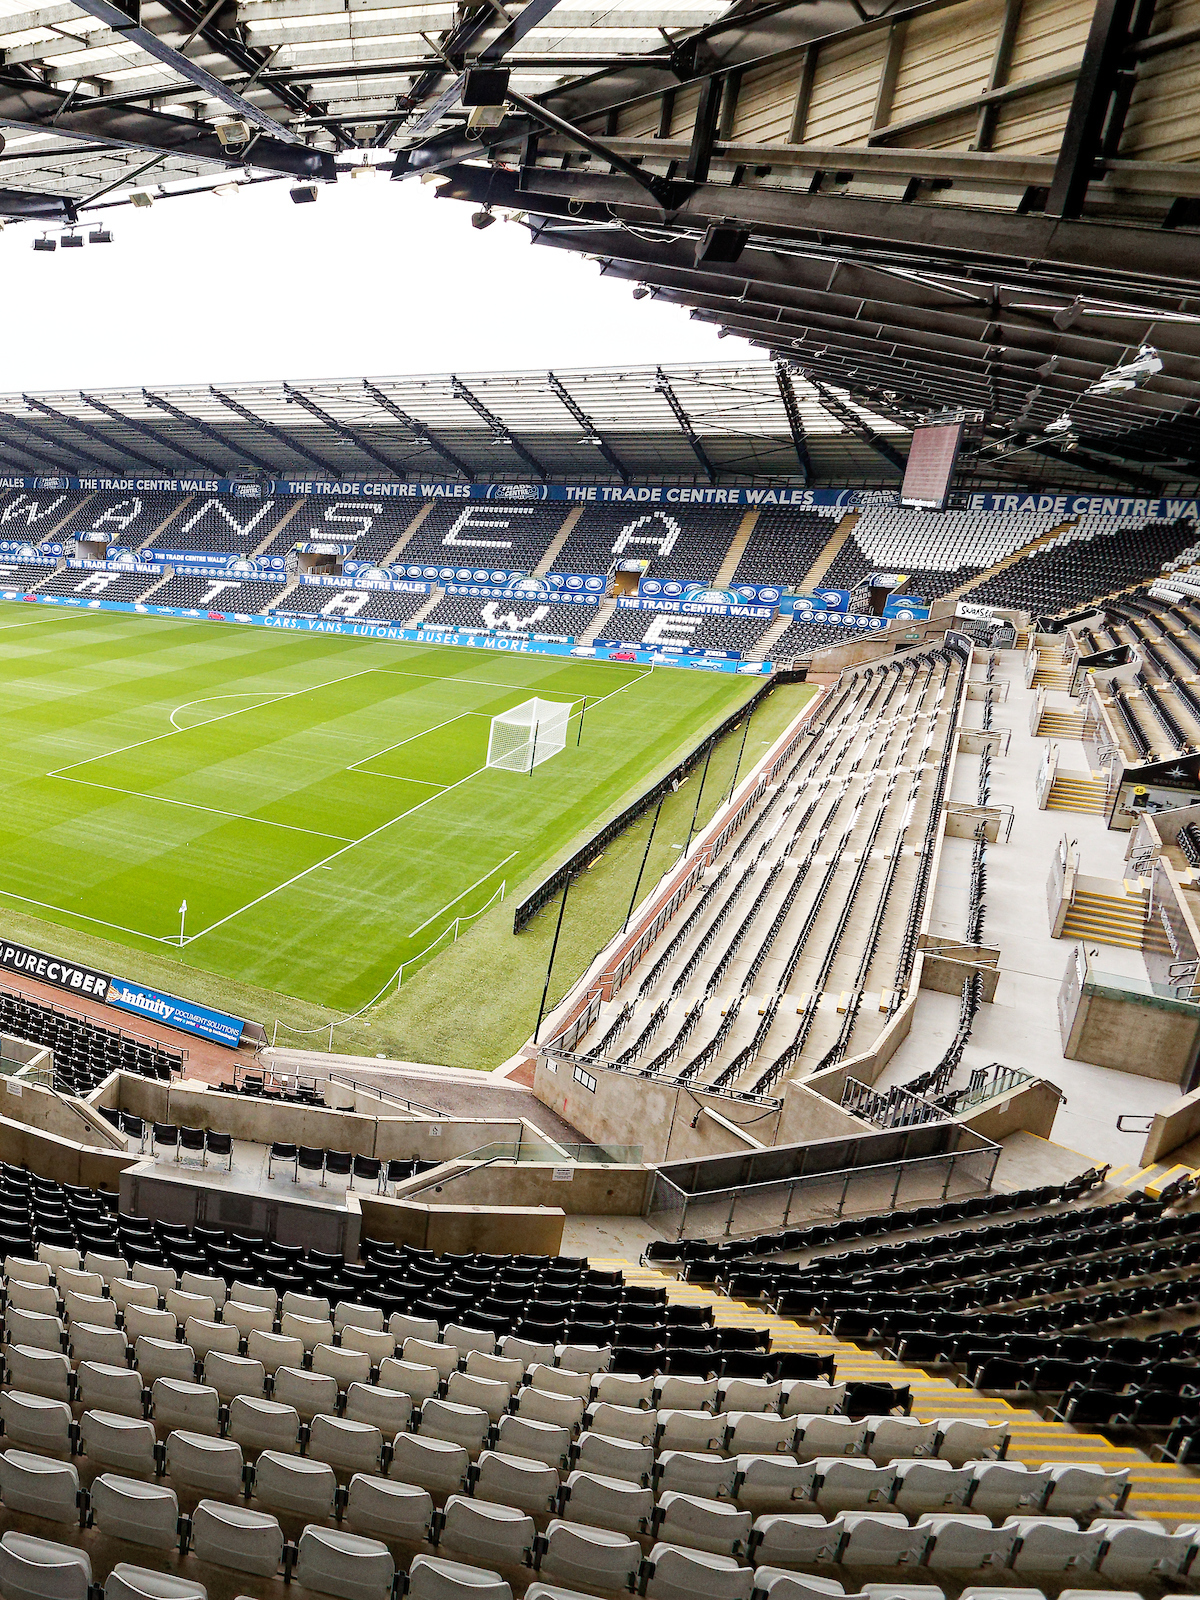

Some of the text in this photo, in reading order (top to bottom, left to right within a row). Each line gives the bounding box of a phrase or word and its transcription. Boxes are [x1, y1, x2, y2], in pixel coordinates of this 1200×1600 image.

[79, 479, 218, 492] THE TRADE CENTRE WALES
[288, 482, 471, 497] THE TRADE CENTRE WALES
[565, 487, 814, 505] THE TRADE CENTRE WALES
[991, 495, 1067, 513] TRADE
[1072, 498, 1160, 517] CENTRE
[69, 559, 161, 573] THE TRADE CENTRE WALES
[303, 576, 426, 593] THE TRADE CENTRE WALES
[619, 599, 771, 618] THE TRADE CENTRE WALES
[264, 616, 301, 629] CARS,
[308, 620, 346, 634] VANS,
[353, 624, 409, 640] LUTONS,
[416, 631, 459, 645] BUSES
[466, 637, 475, 647] &
[2, 946, 107, 997] PURECYBER
[120, 988, 176, 1019] Infinity
[175, 1009, 240, 1036] DOCUMENT SOLUTIONS
